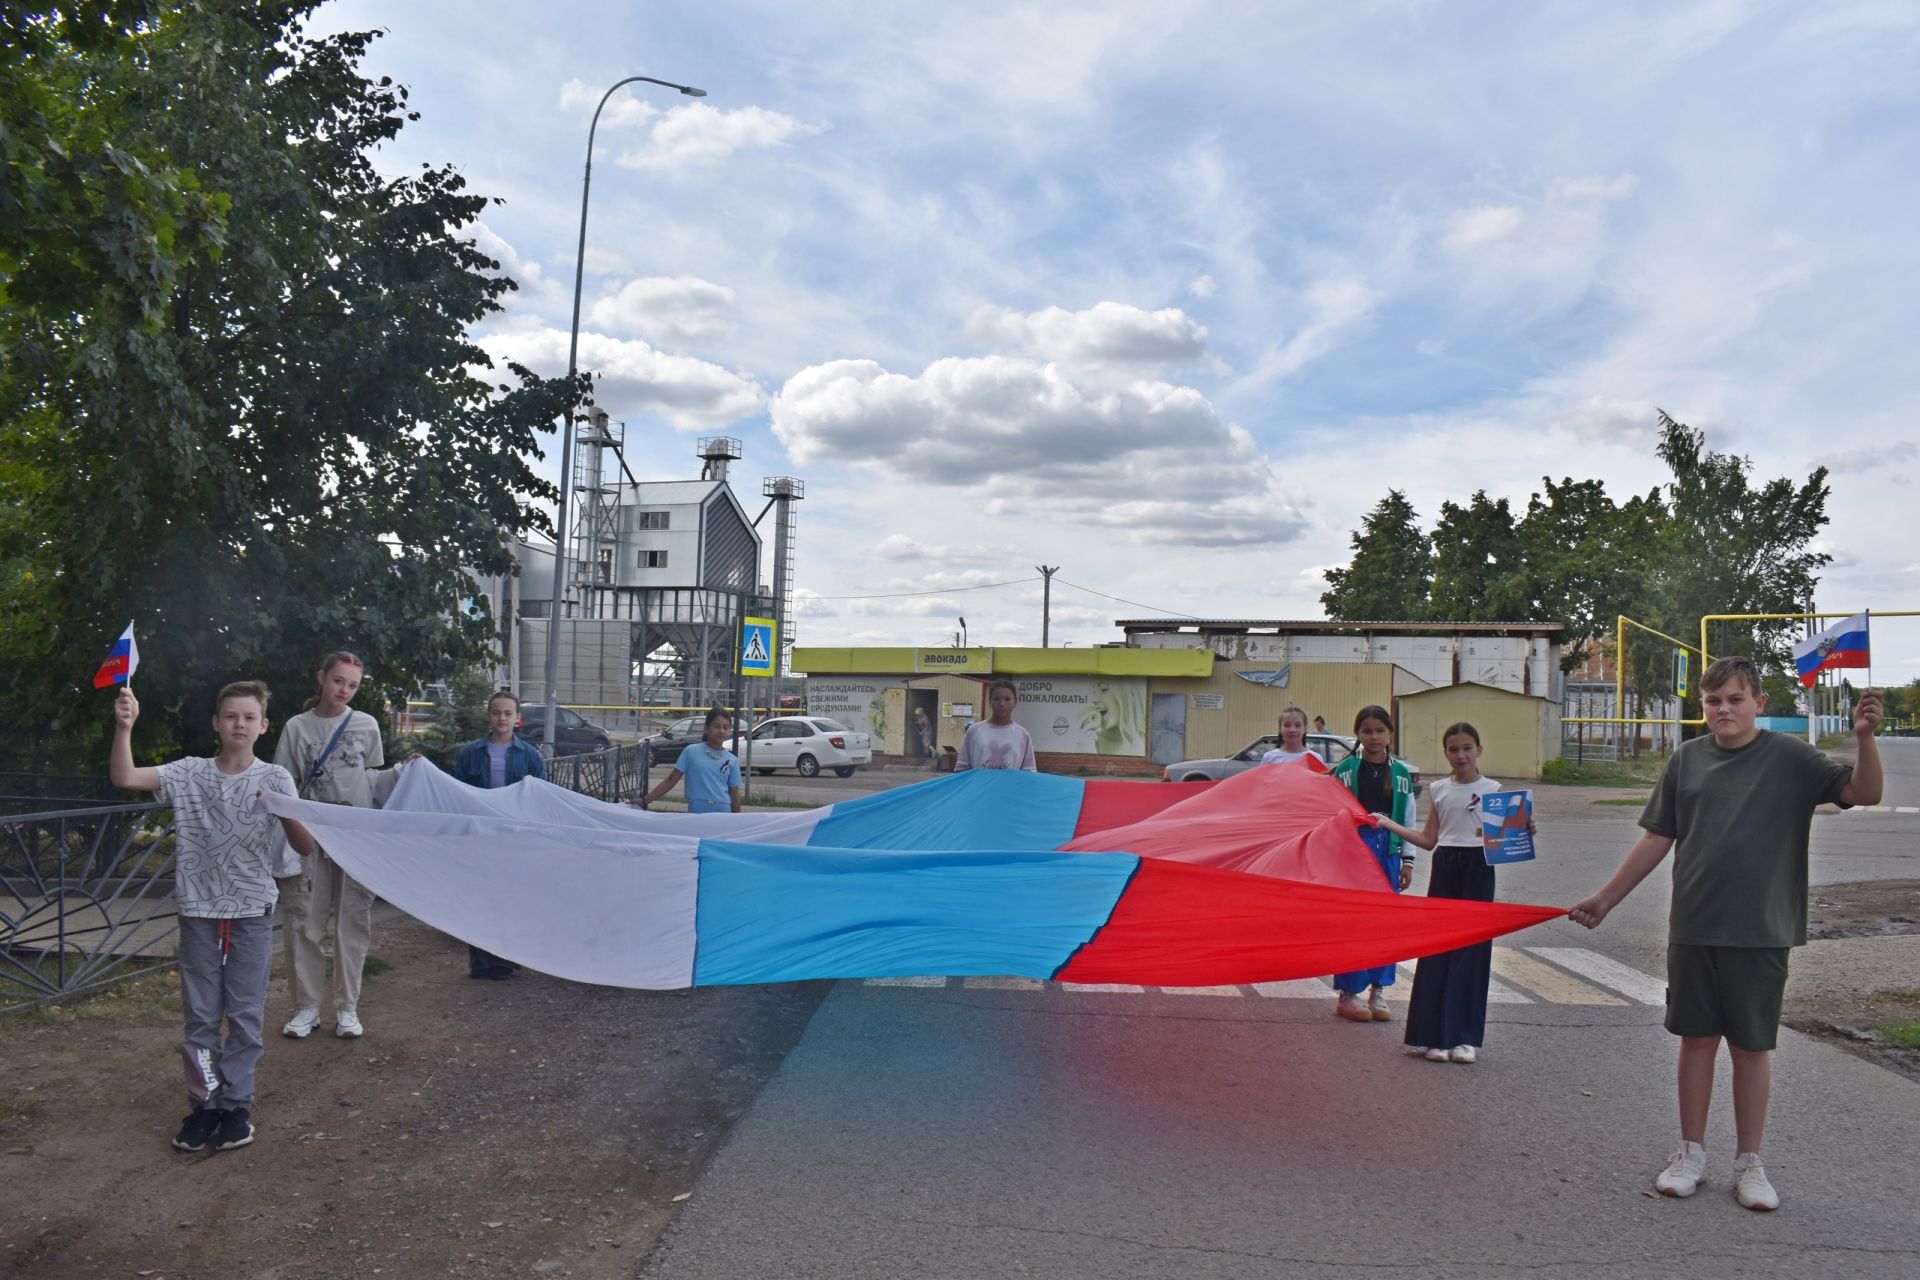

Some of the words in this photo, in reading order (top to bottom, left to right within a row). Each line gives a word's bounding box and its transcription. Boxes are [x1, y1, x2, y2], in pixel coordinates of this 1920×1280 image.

[924, 654, 968, 665] авокадо
[810, 684, 876, 693] НАСЛАЖДАЙТЕСЬ
[1018, 682, 1053, 692] ДОБРО
[810, 695, 849, 703] СВЕЖИМИ
[1018, 693, 1088, 704] ПОЖАЛОВАТЬ!
[811, 704, 862, 713] ПРОДУКТАМИ!
[1489, 798, 1502, 807] 22
